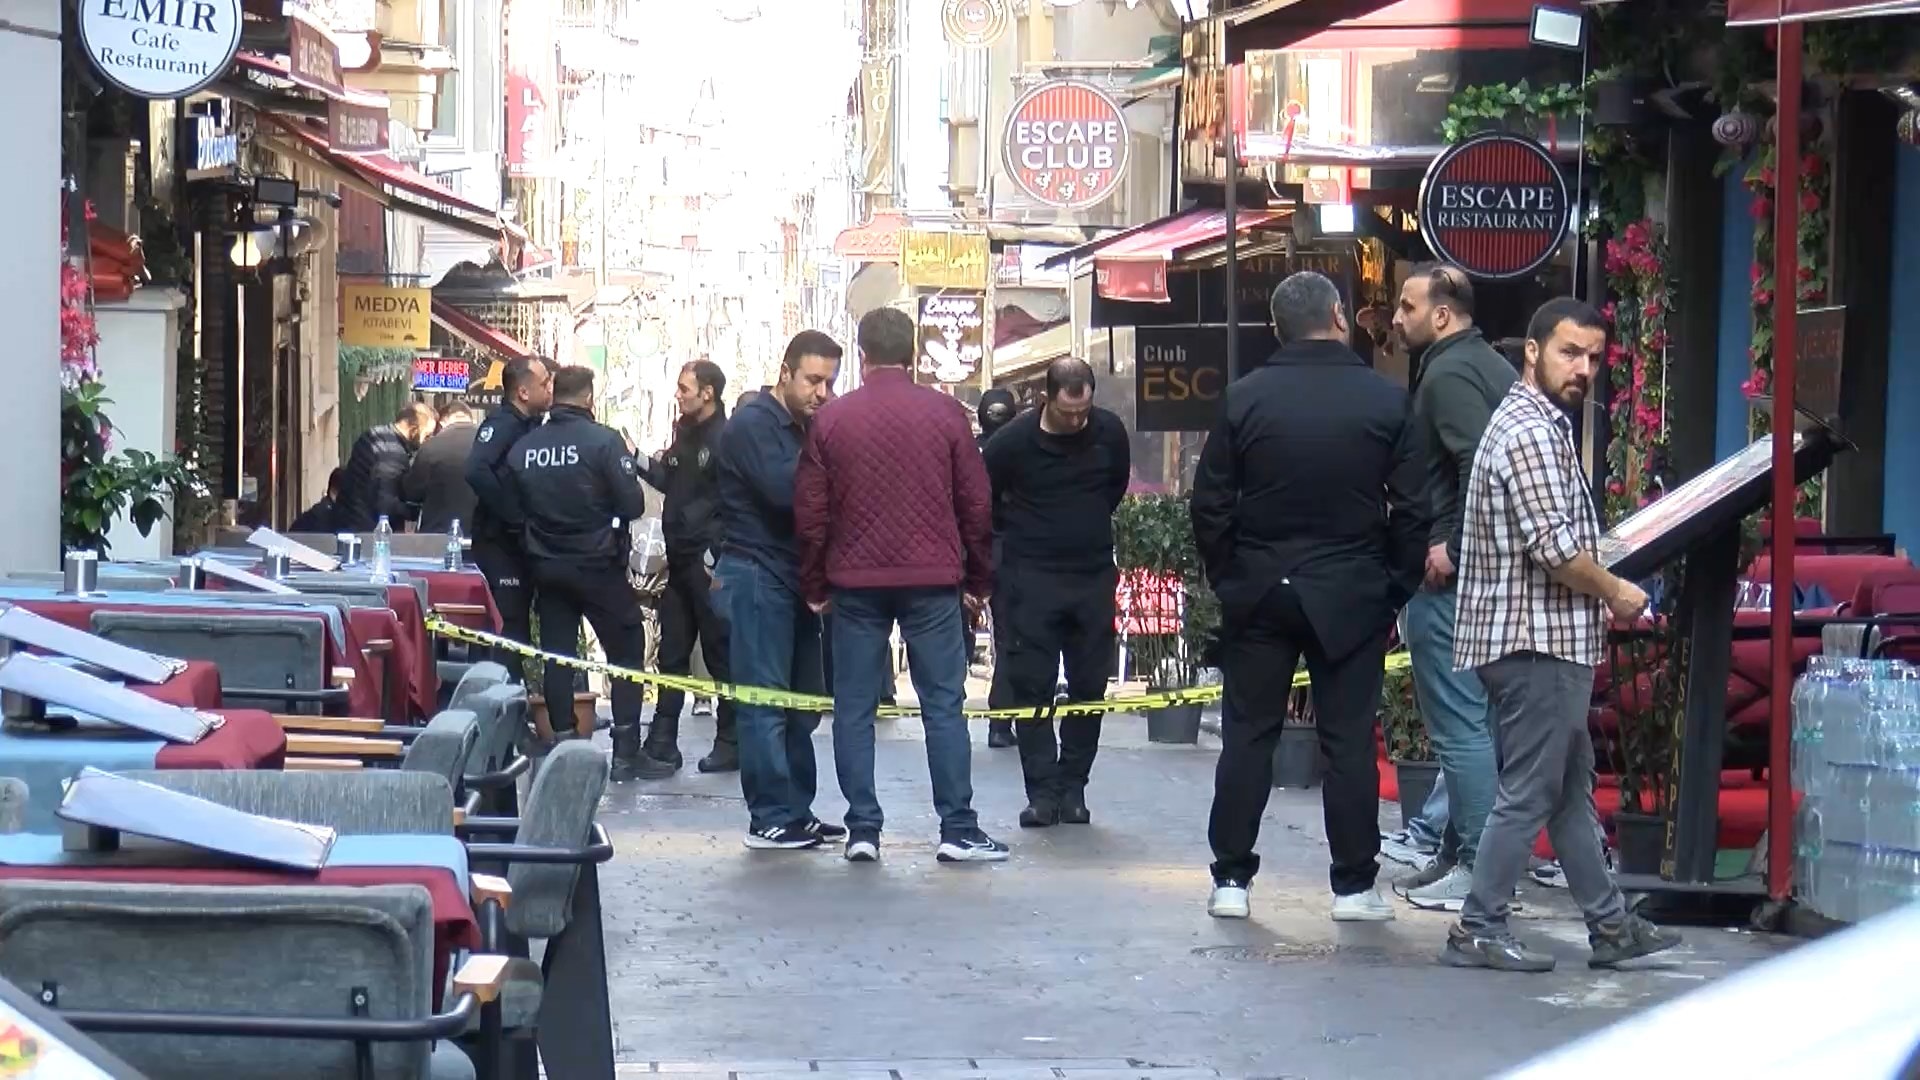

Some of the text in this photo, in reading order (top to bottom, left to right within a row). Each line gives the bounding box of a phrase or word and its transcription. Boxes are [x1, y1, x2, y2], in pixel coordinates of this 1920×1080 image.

[131, 27, 180, 51] Cafe
[100, 47, 209, 76] Restaurant
[1016, 120, 1118, 145] ESCAPE
[1022, 146, 1113, 169] CLUB
[1441, 184, 1555, 211] ESCAPE
[1437, 210, 1557, 230] RESTAURANT
[354, 295, 420, 314] MEDYA
[1143, 344, 1187, 363] Club
[1665, 637, 1690, 850] ESCAPE
